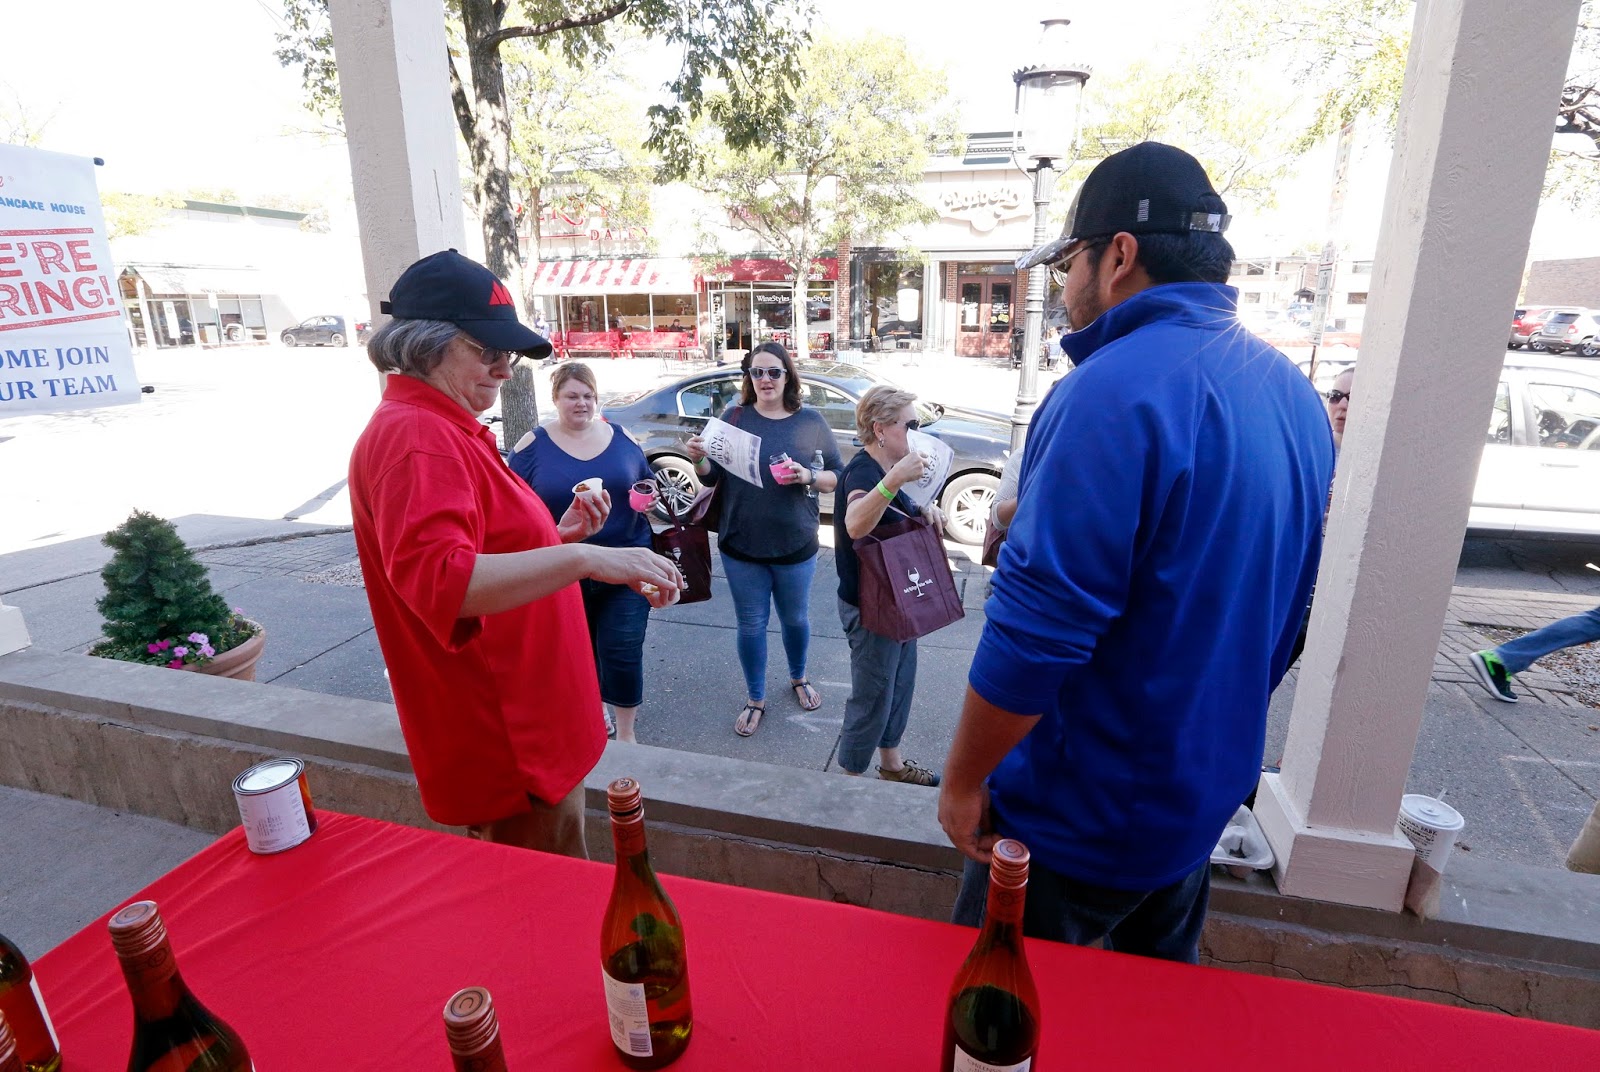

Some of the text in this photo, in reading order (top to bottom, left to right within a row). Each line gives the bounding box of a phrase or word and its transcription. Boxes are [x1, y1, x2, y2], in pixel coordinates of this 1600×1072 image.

[0, 196, 86, 215] ANCAKE HOUSE
[0, 240, 98, 277] E'RE
[0, 275, 115, 318] RING!
[756, 294, 790, 303] WineStyles
[0, 346, 110, 371] ME JOIN
[0, 374, 118, 402] UR TEAM
